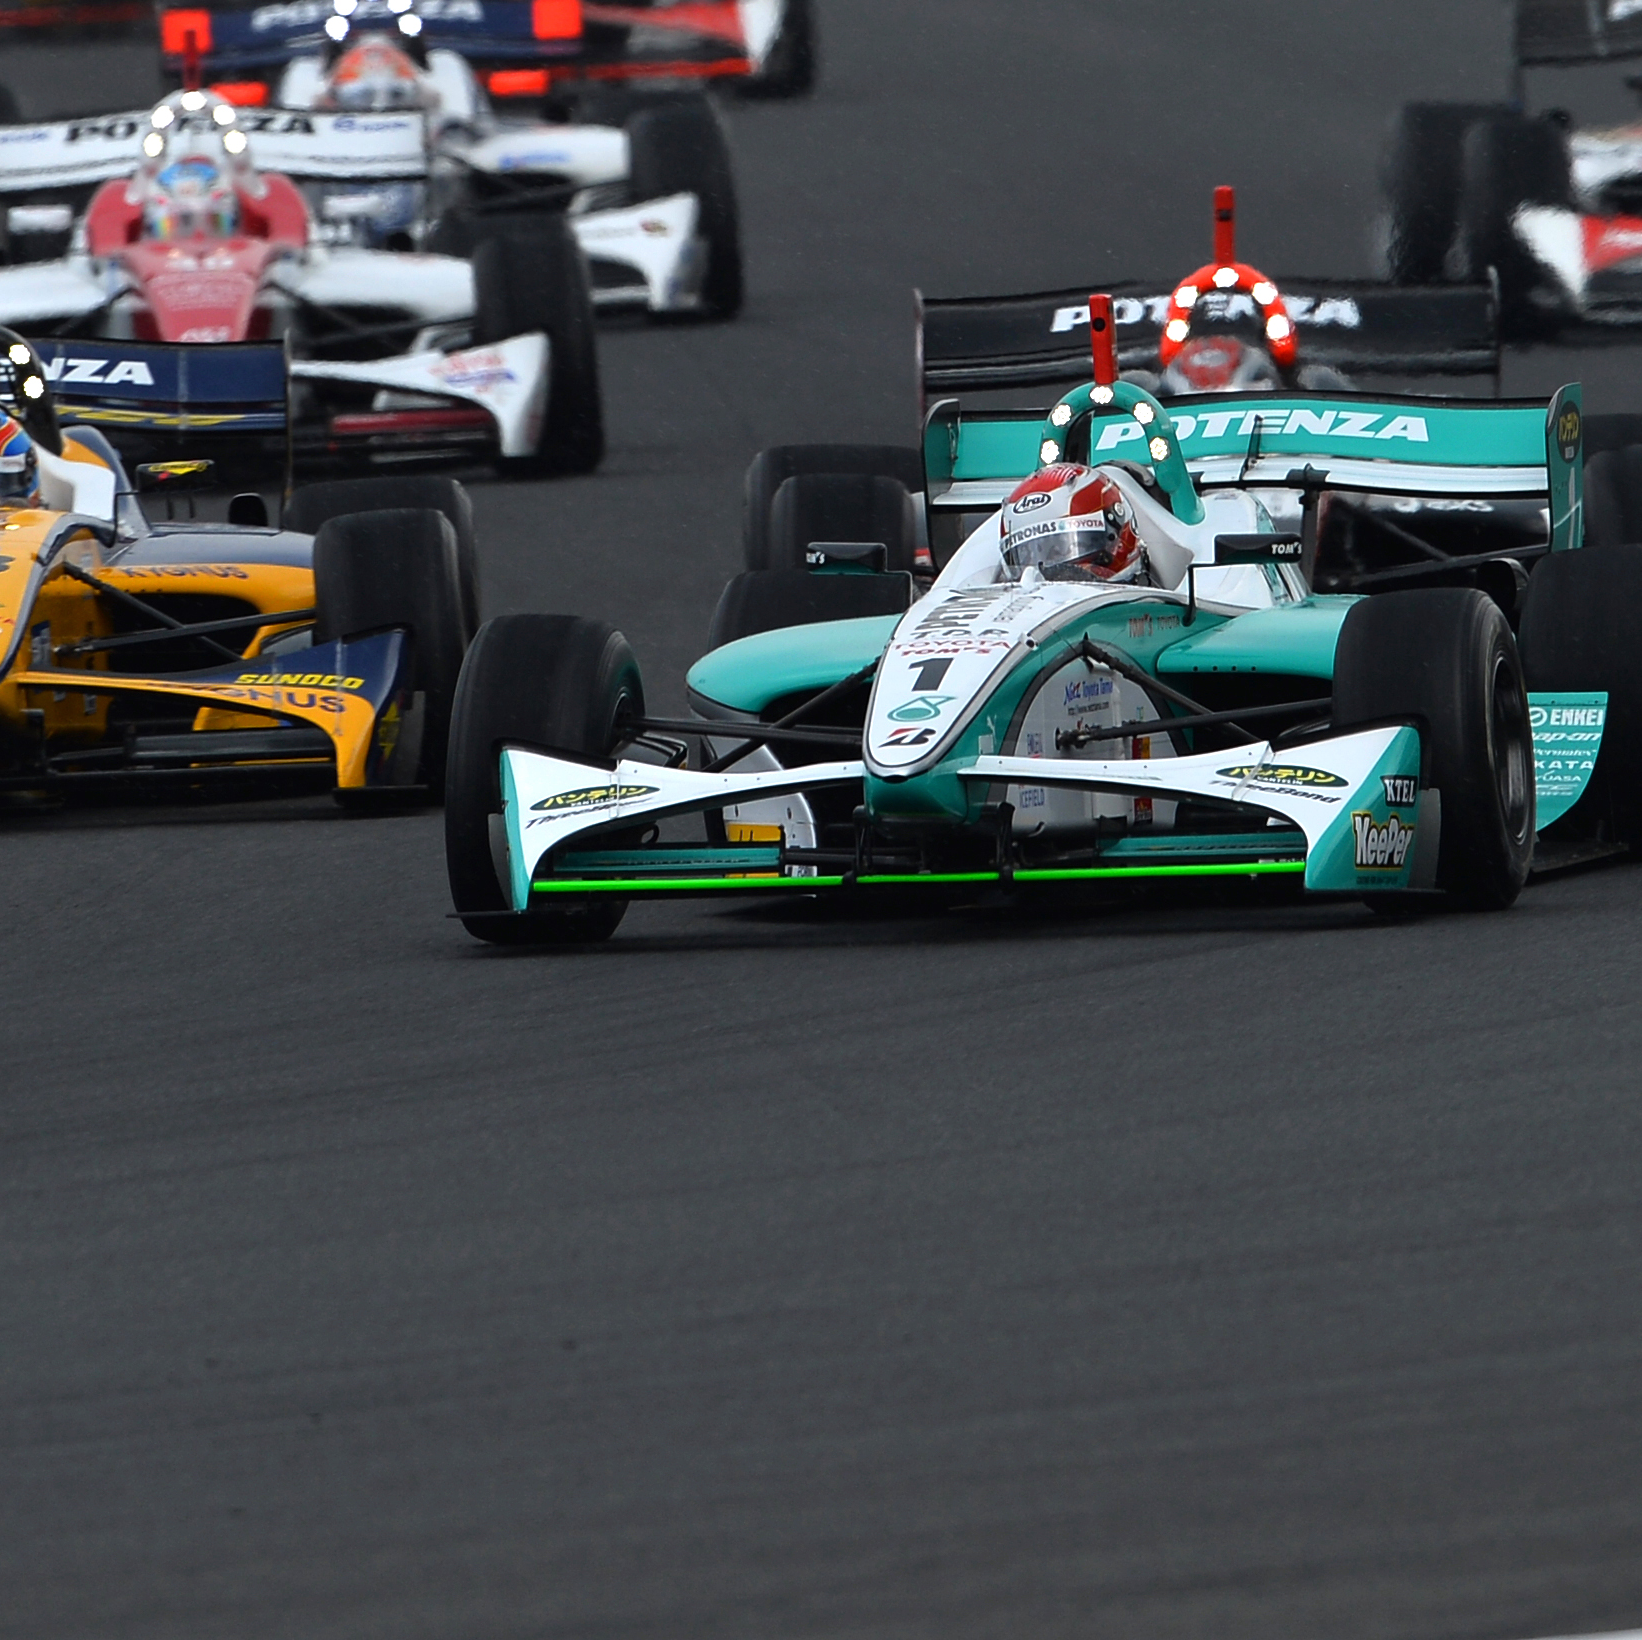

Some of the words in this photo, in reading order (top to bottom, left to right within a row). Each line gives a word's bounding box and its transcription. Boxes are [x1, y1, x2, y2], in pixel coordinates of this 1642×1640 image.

[233, 674, 365, 689] SUNOCO
[908, 657, 954, 691] 1
[1550, 708, 1603, 726] ENKEI
[1384, 778, 1416, 803] KTEL
